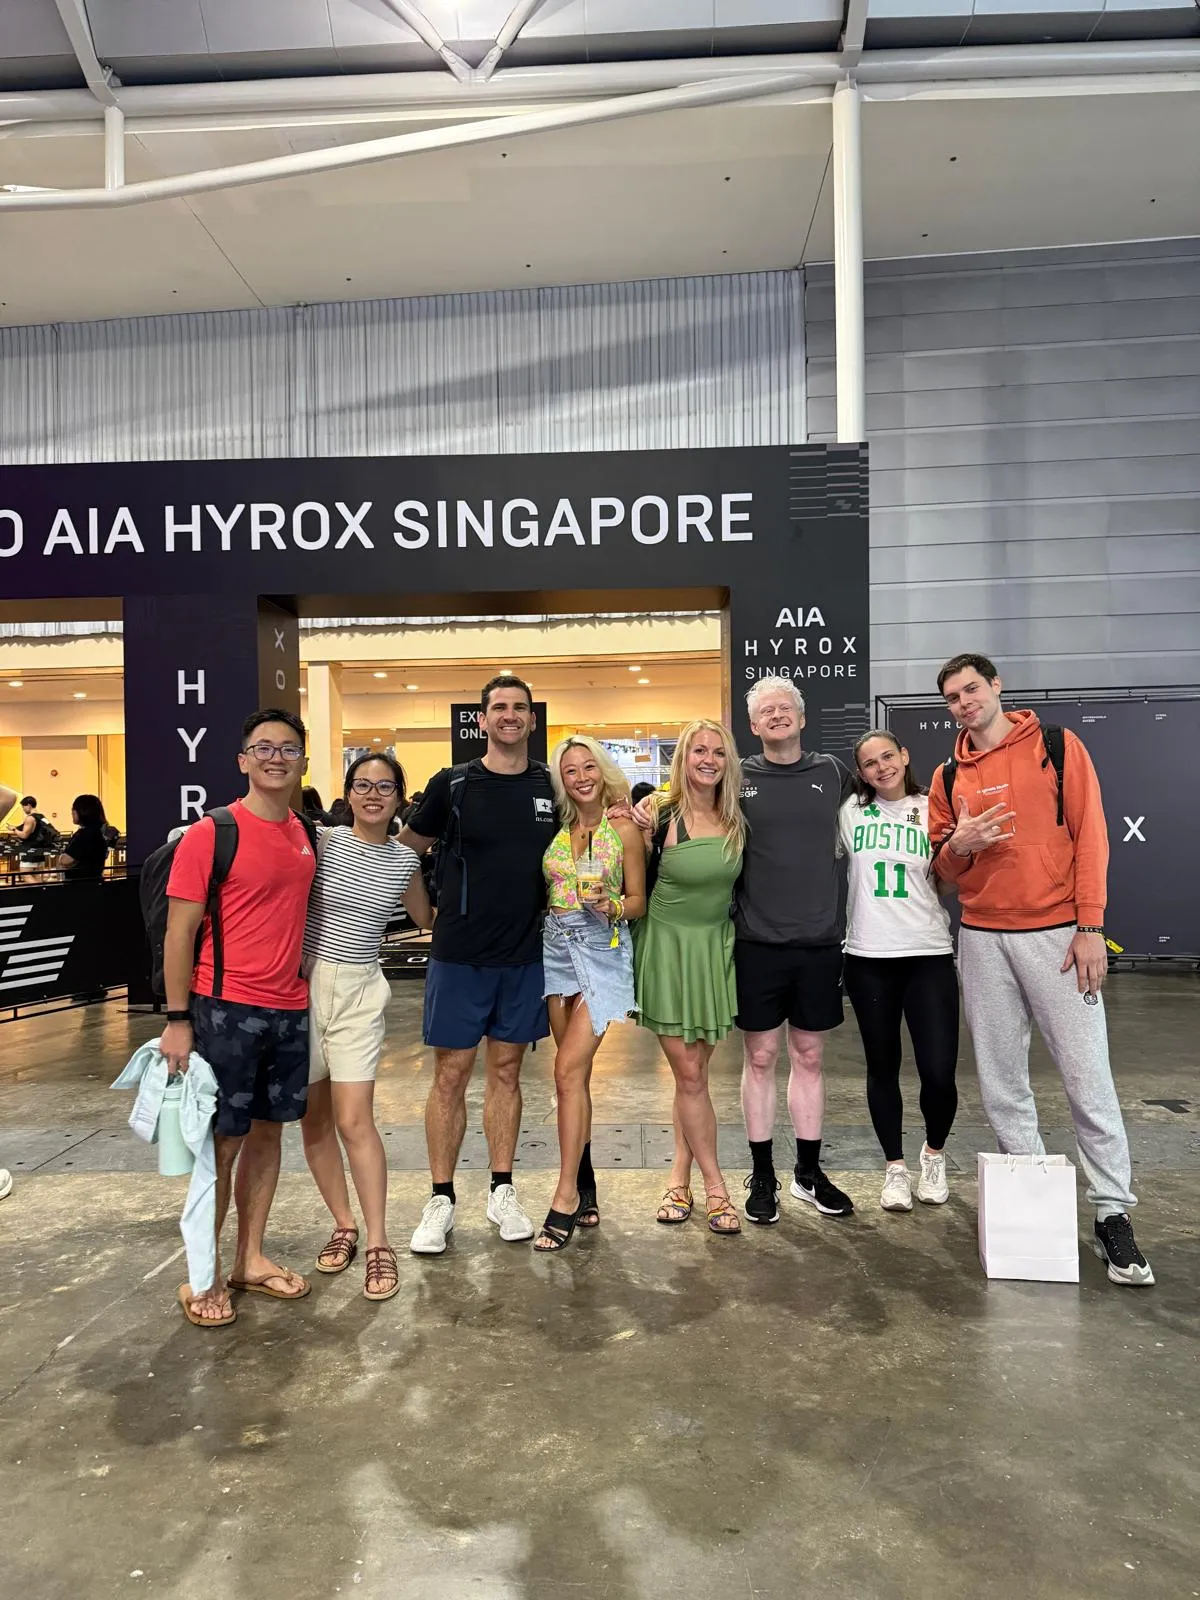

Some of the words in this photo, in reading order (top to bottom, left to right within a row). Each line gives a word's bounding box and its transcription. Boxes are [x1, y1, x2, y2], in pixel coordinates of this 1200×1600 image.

[43, 507, 145, 556] AIA
[164, 501, 375, 552] HYROX
[393, 492, 753, 549] SINGAPORE
[775, 606, 826, 628] AIA
[744, 636, 857, 656] HYROX
[745, 664, 857, 680] SINGAPORE
[460, 711, 480, 723] EXI
[919, 720, 963, 730] HYRO
[460, 728, 487, 739] ONL
[177, 669, 208, 821] HYR
[1122, 816, 1147, 842] X
[853, 822, 930, 860] BOSTON
[873, 861, 909, 898] 11
